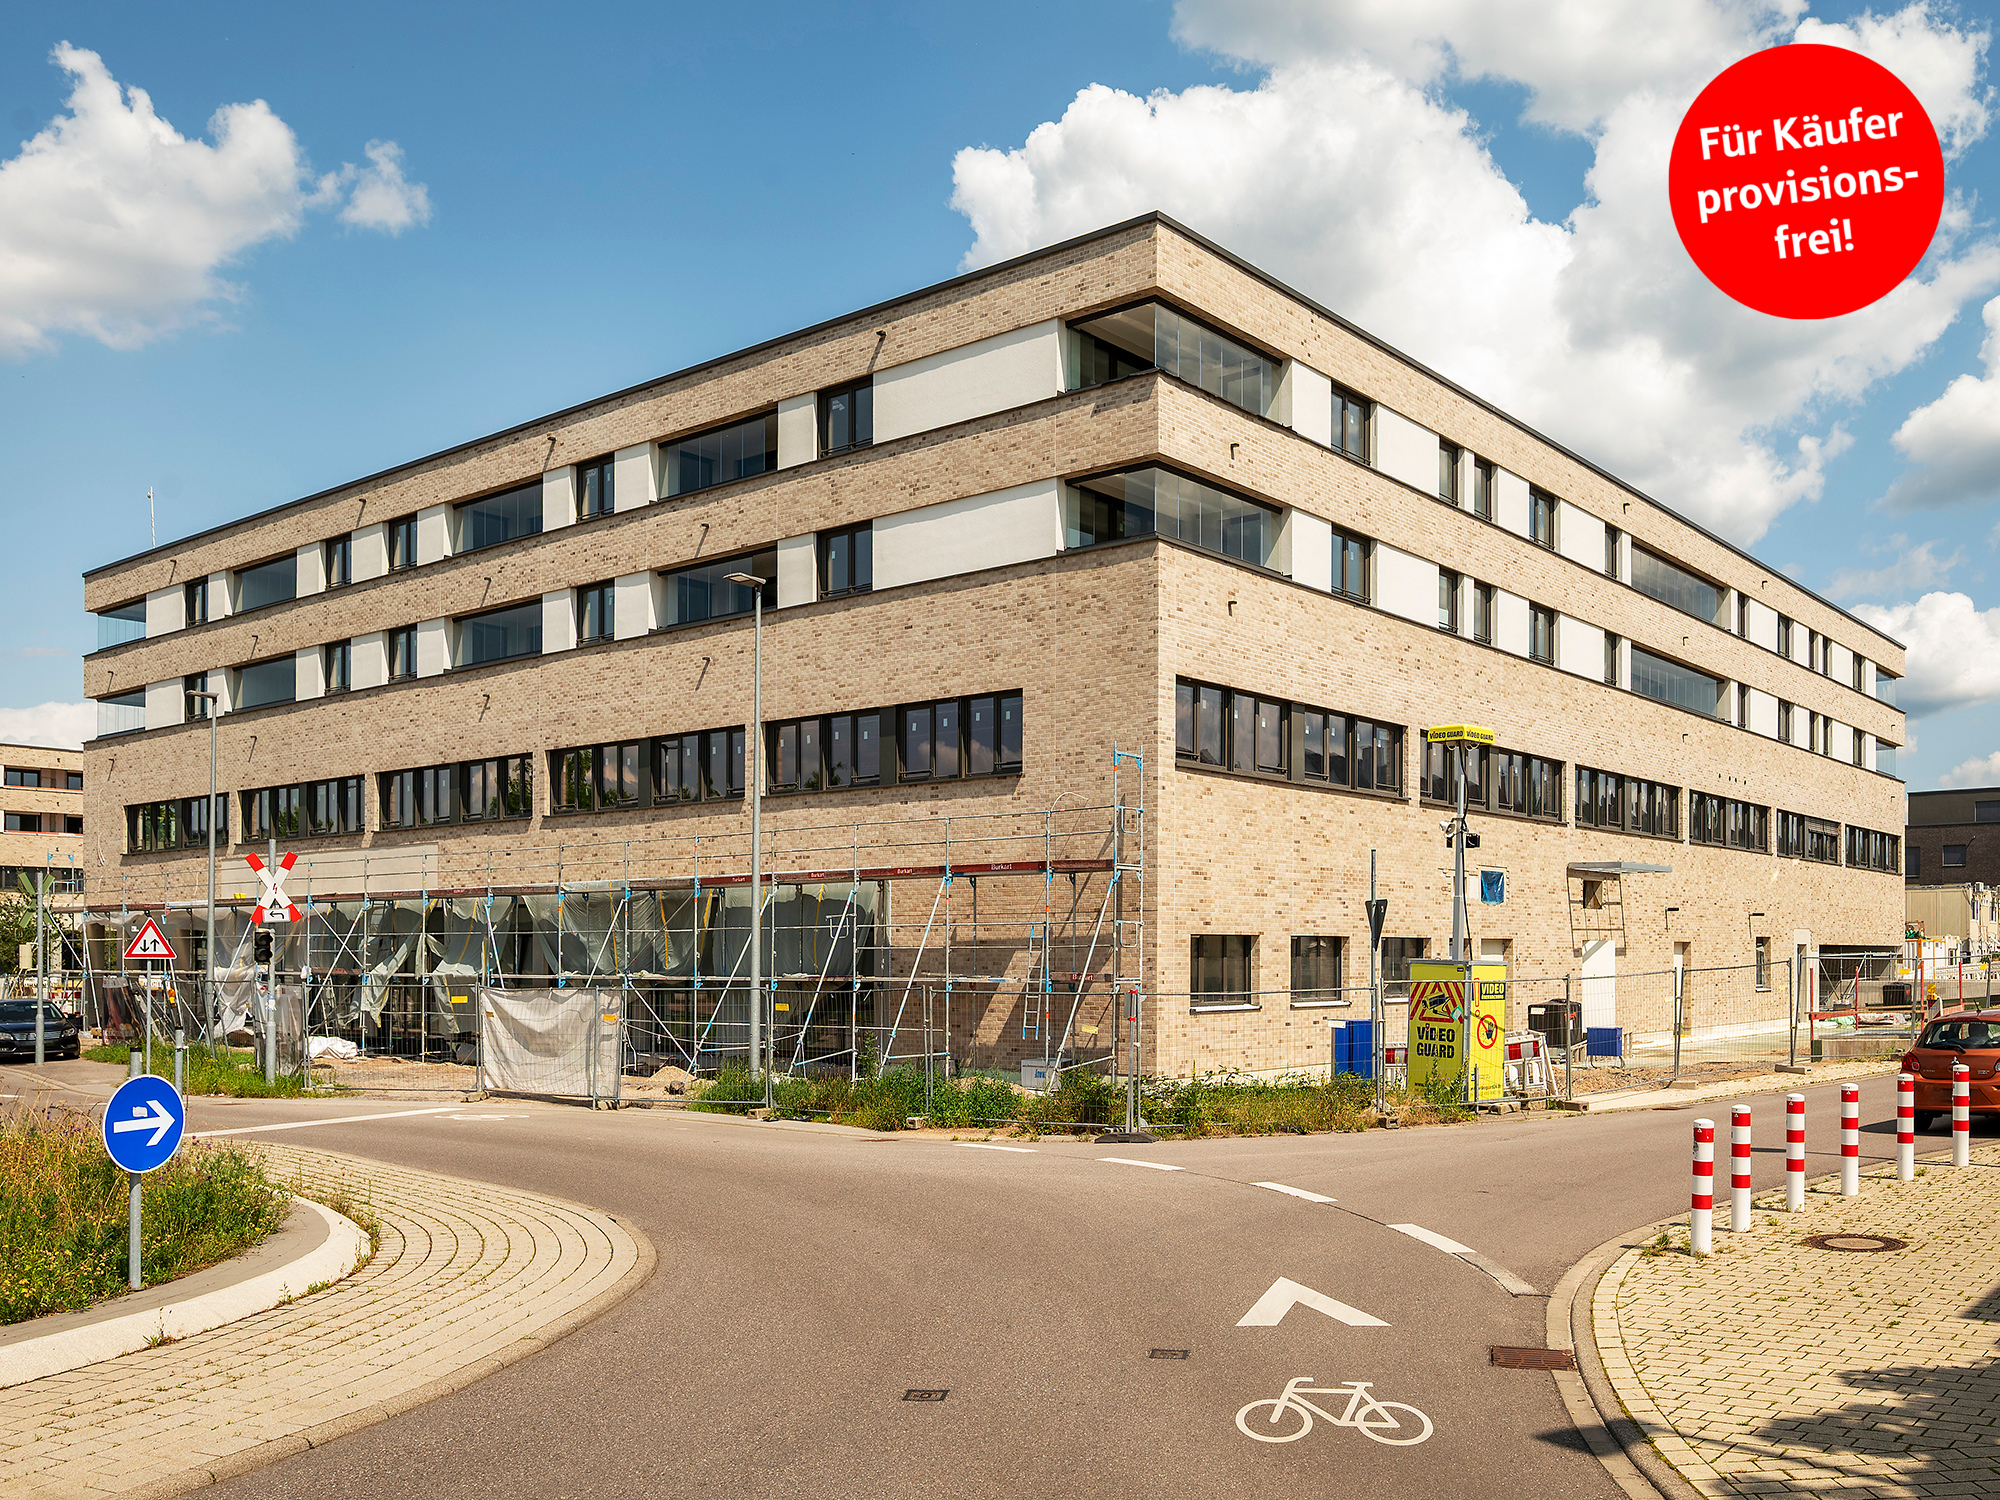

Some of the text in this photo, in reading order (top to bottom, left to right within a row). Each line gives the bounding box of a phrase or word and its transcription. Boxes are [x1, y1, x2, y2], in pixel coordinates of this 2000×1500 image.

[1430, 731, 1446, 739] VIDEO
[1481, 983, 1504, 995] VIDEO
[1416, 1025, 1455, 1042] VIDEO
[1417, 1043, 1455, 1059] GUARD
